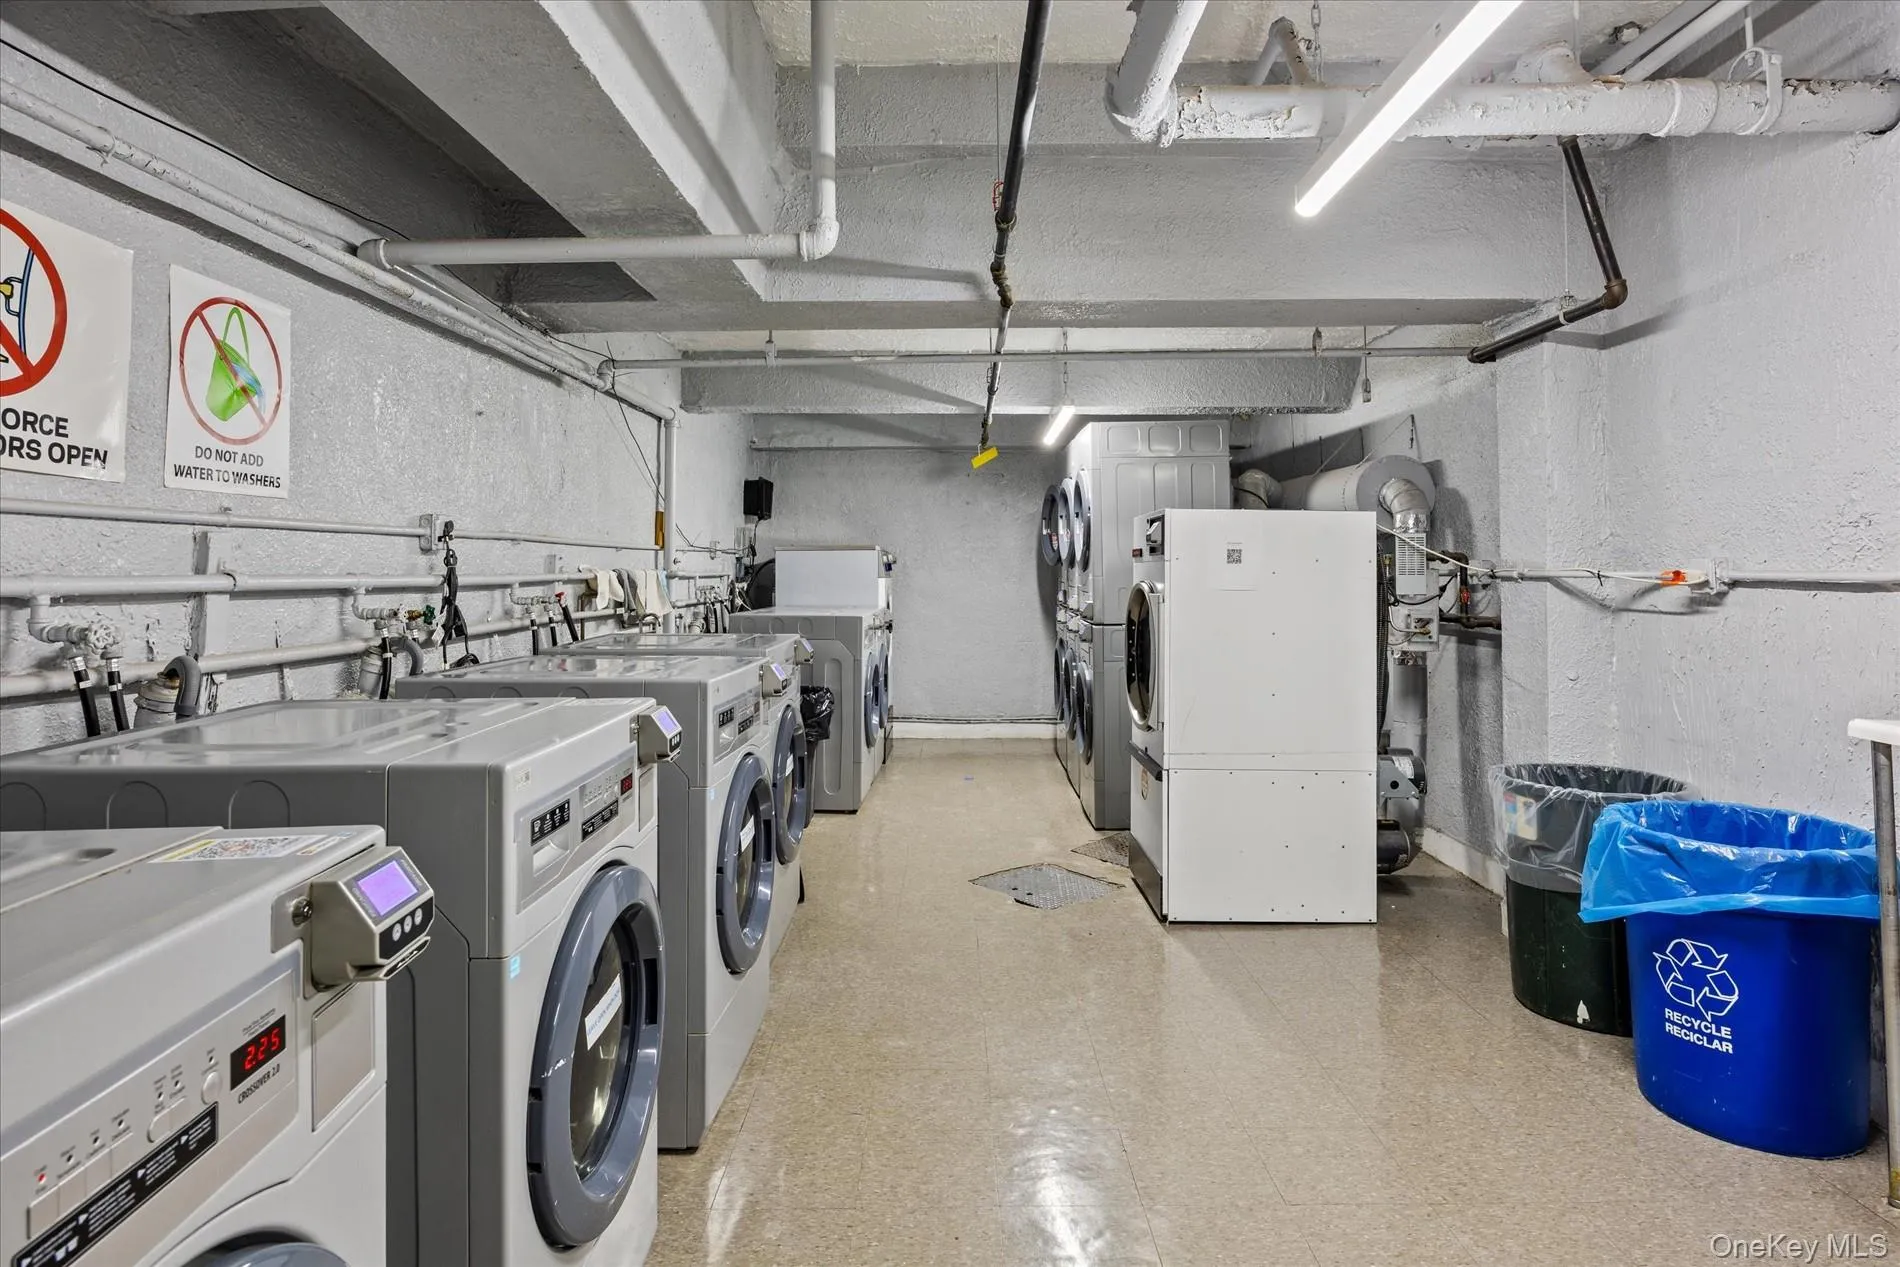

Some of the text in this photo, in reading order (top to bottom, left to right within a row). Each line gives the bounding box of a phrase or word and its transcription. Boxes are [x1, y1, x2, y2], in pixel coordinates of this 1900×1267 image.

[2, 408, 69, 438] ORCE
[48, 442, 108, 469] OPEN
[195, 445, 264, 467] DO NOT ADD
[174, 464, 281, 488] WATER TO WASHERS
[1665, 1007, 1732, 1039] RECYCLE
[1665, 1021, 1734, 1054] RECICLAR
[238, 1063, 281, 1104] CROSSOVER 2.0
